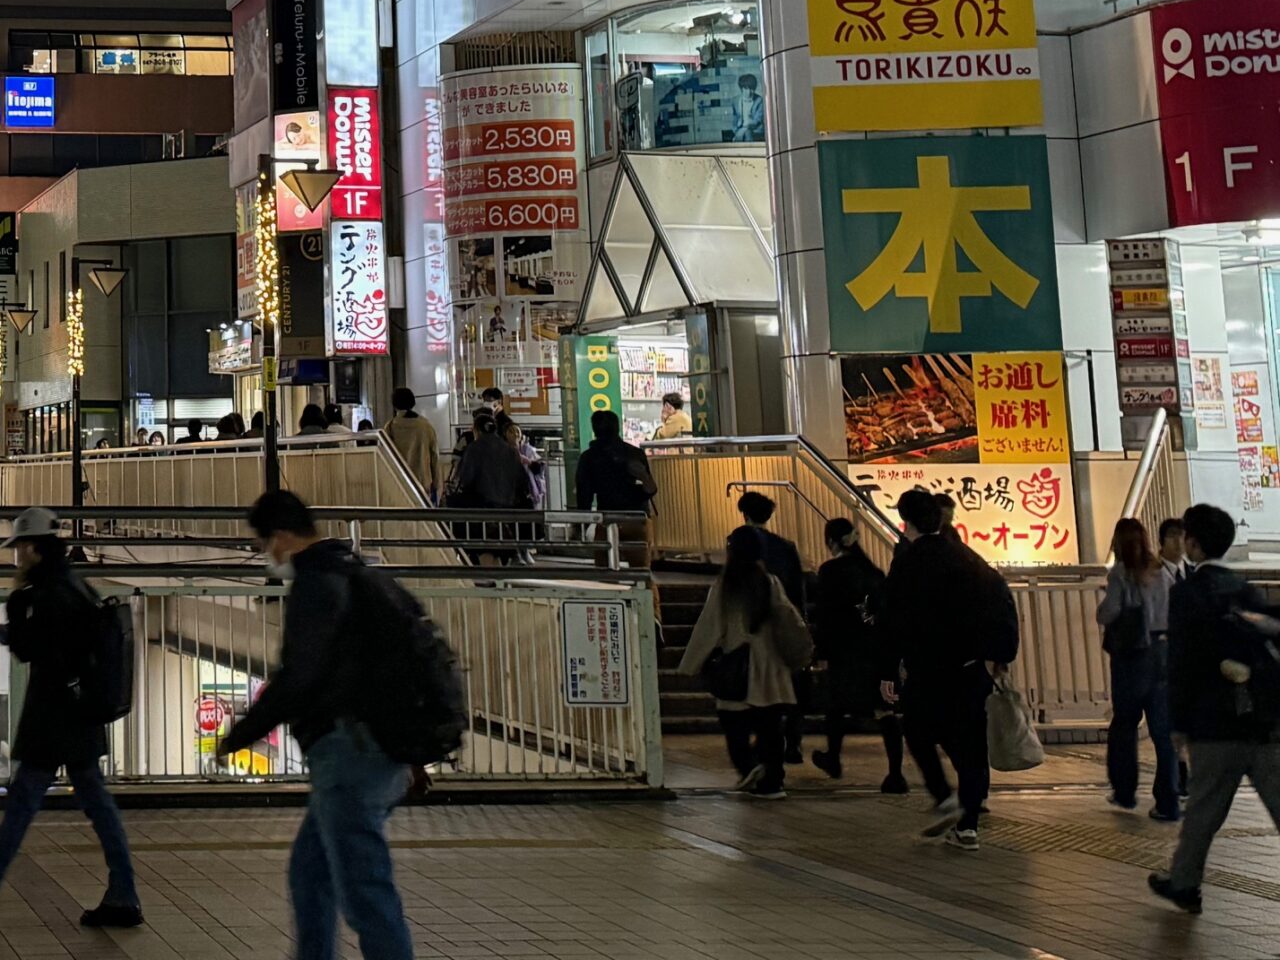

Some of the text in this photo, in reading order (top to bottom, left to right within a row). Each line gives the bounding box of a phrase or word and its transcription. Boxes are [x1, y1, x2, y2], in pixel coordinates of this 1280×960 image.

[836, 53, 1012, 81] TORIKIZOKU
[485, 126, 571, 151] 2,530円
[487, 164, 574, 189] 5,830円
[344, 191, 368, 215] 1F
[488, 203, 575, 227] 6,600円
[841, 154, 1040, 333] 本
[284, 278, 292, 333] CENTURY
[587, 345, 611, 412] BOO
[977, 361, 1060, 391] お通し
[991, 399, 1051, 429] 席料
[983, 437, 1065, 453] ございません!
